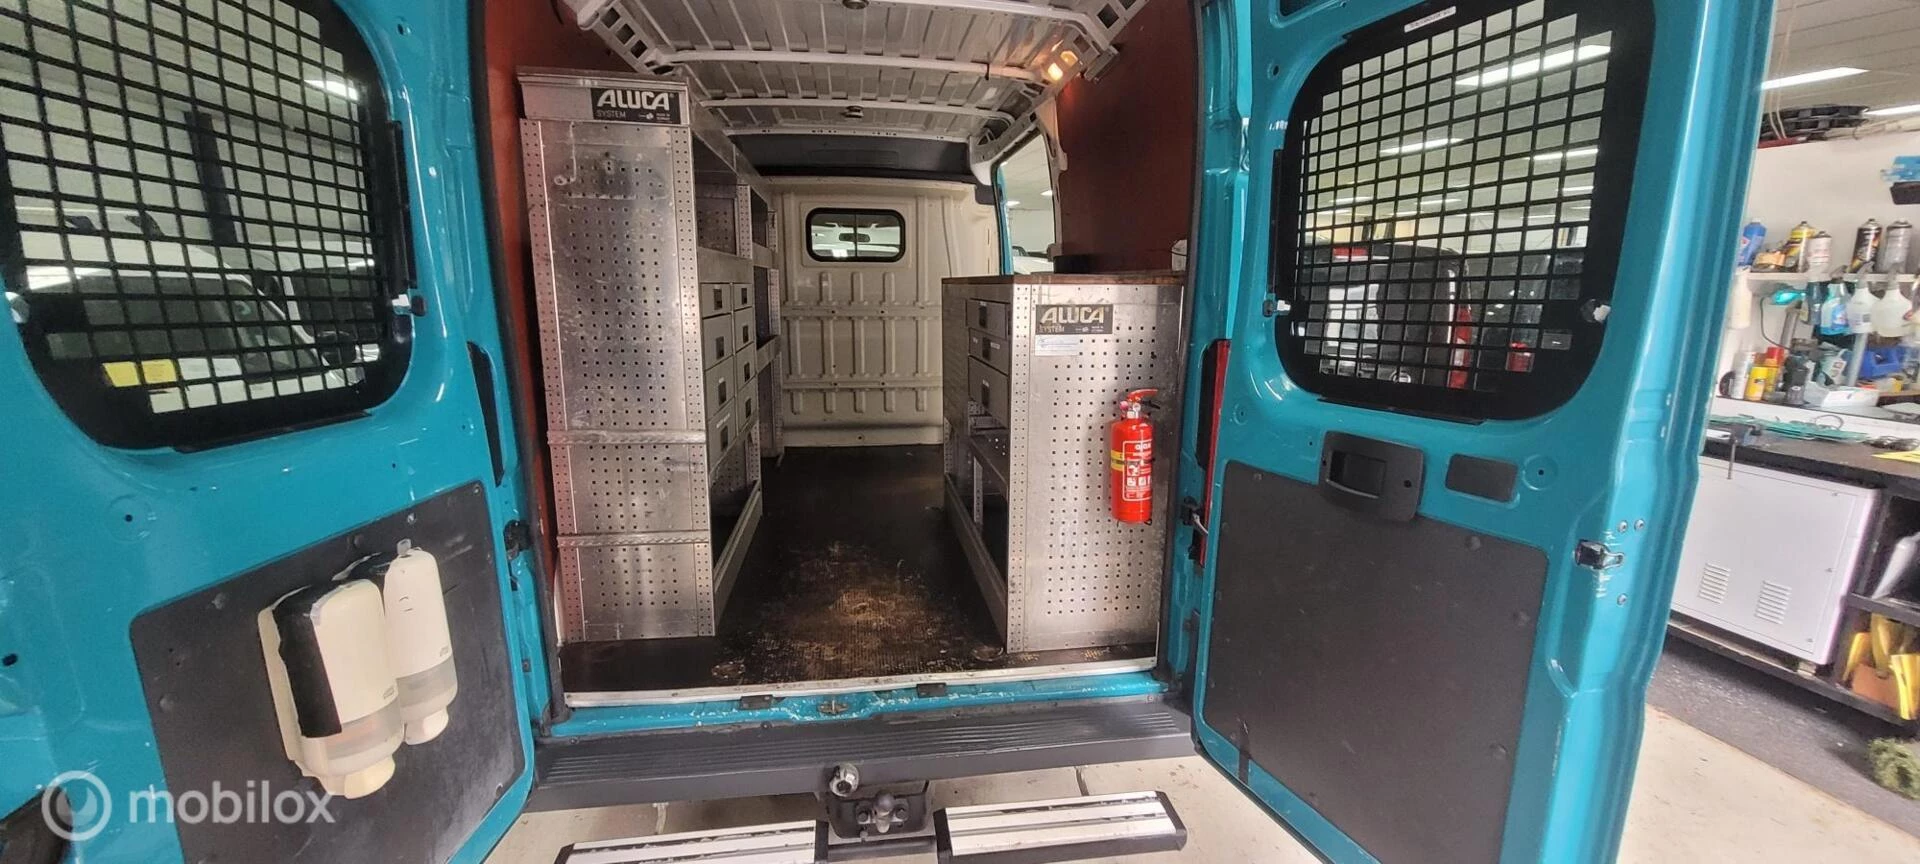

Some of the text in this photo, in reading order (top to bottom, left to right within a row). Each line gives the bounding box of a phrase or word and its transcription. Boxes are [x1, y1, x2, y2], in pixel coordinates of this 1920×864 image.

[597, 89, 670, 111] ALUCA
[596, 110, 627, 119] SYSTEM
[1040, 306, 1104, 324] ALUCA
